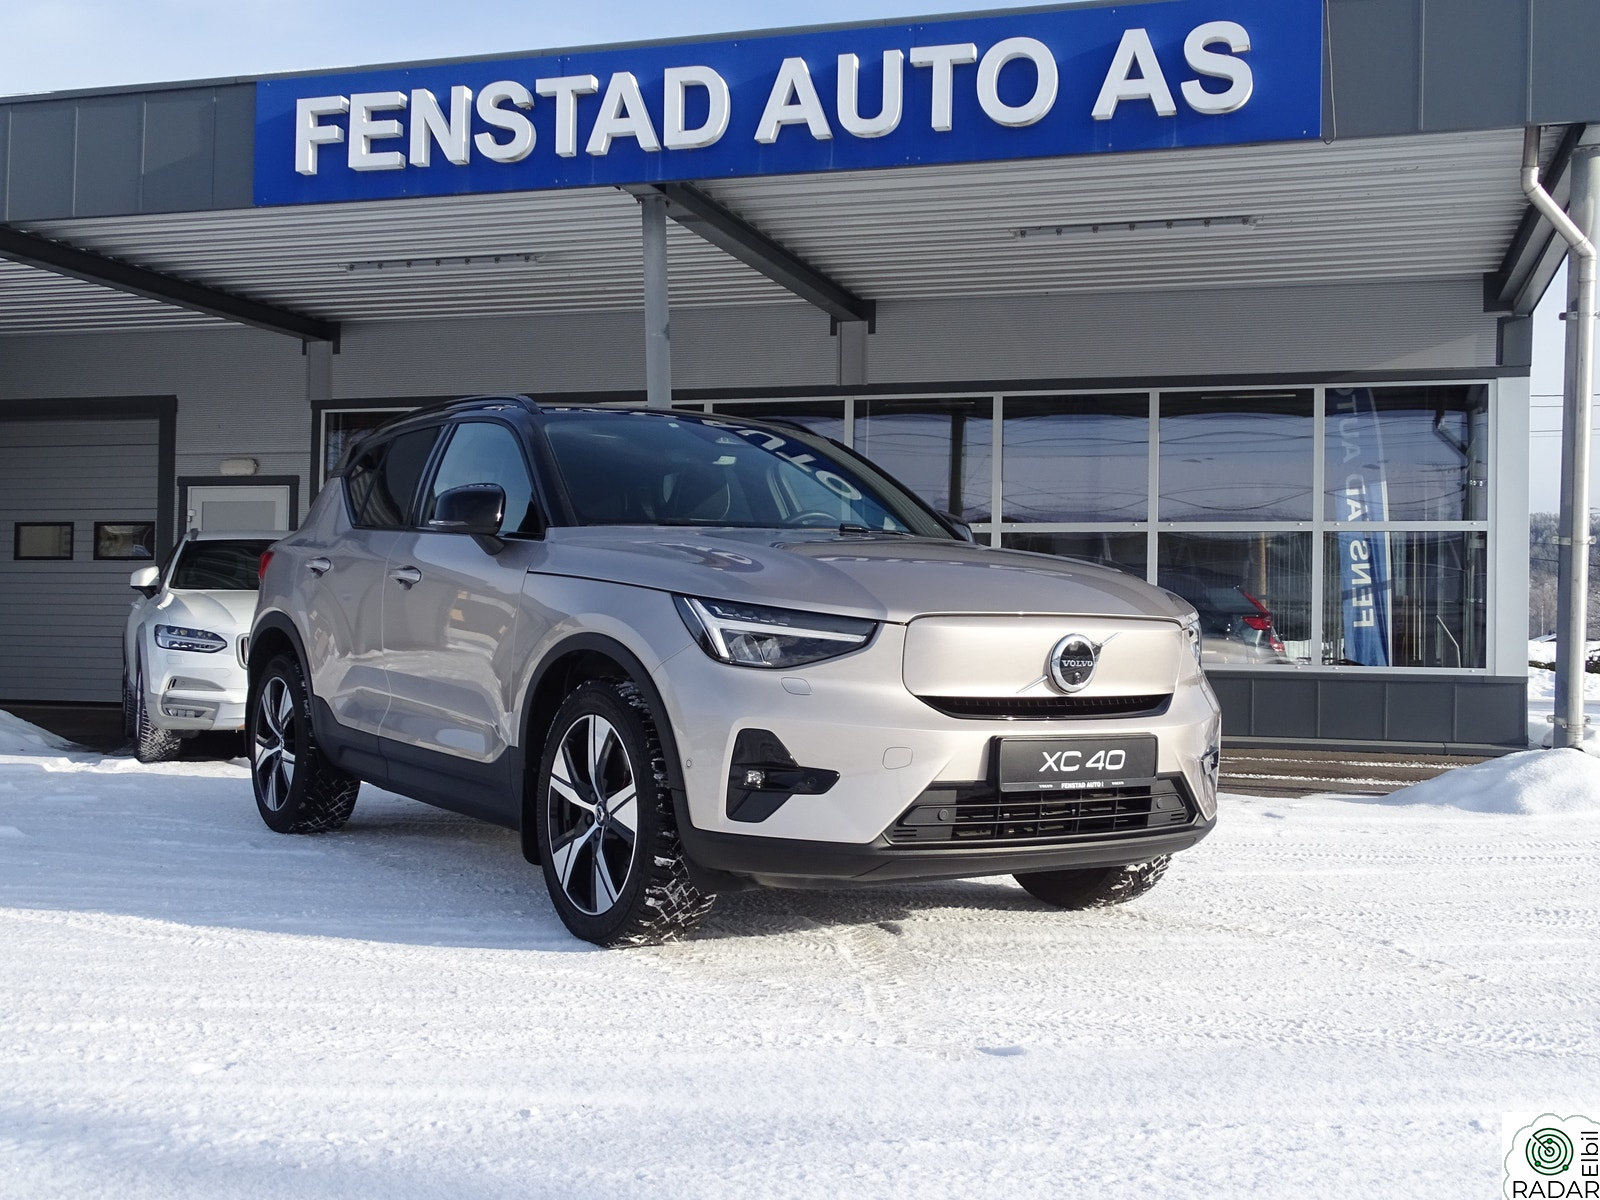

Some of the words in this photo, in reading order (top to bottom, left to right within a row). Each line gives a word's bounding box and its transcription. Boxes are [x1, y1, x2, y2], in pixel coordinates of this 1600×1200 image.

[295, 66, 731, 176] FENSTAD
[753, 37, 1059, 145] AUTO
[1091, 21, 1254, 120] AS
[1038, 751, 1082, 772] XC
[1085, 750, 1126, 771] 40
